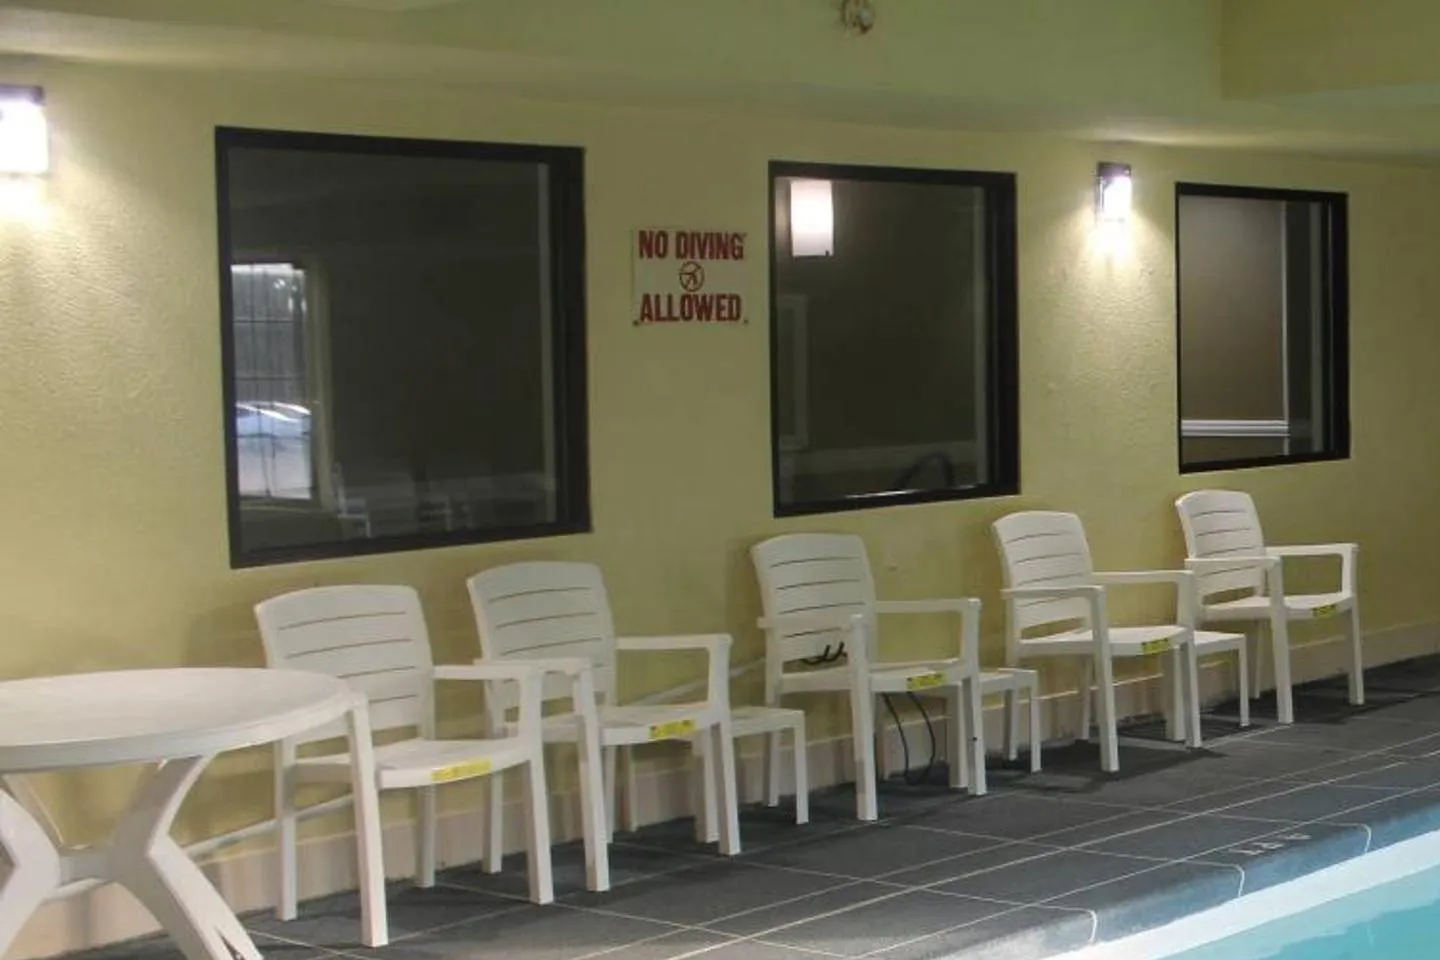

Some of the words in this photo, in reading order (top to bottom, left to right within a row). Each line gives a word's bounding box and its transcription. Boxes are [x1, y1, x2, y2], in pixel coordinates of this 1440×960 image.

[638, 230, 669, 260] NO
[675, 231, 744, 260] DIVING
[640, 293, 742, 322] ALLOWED
